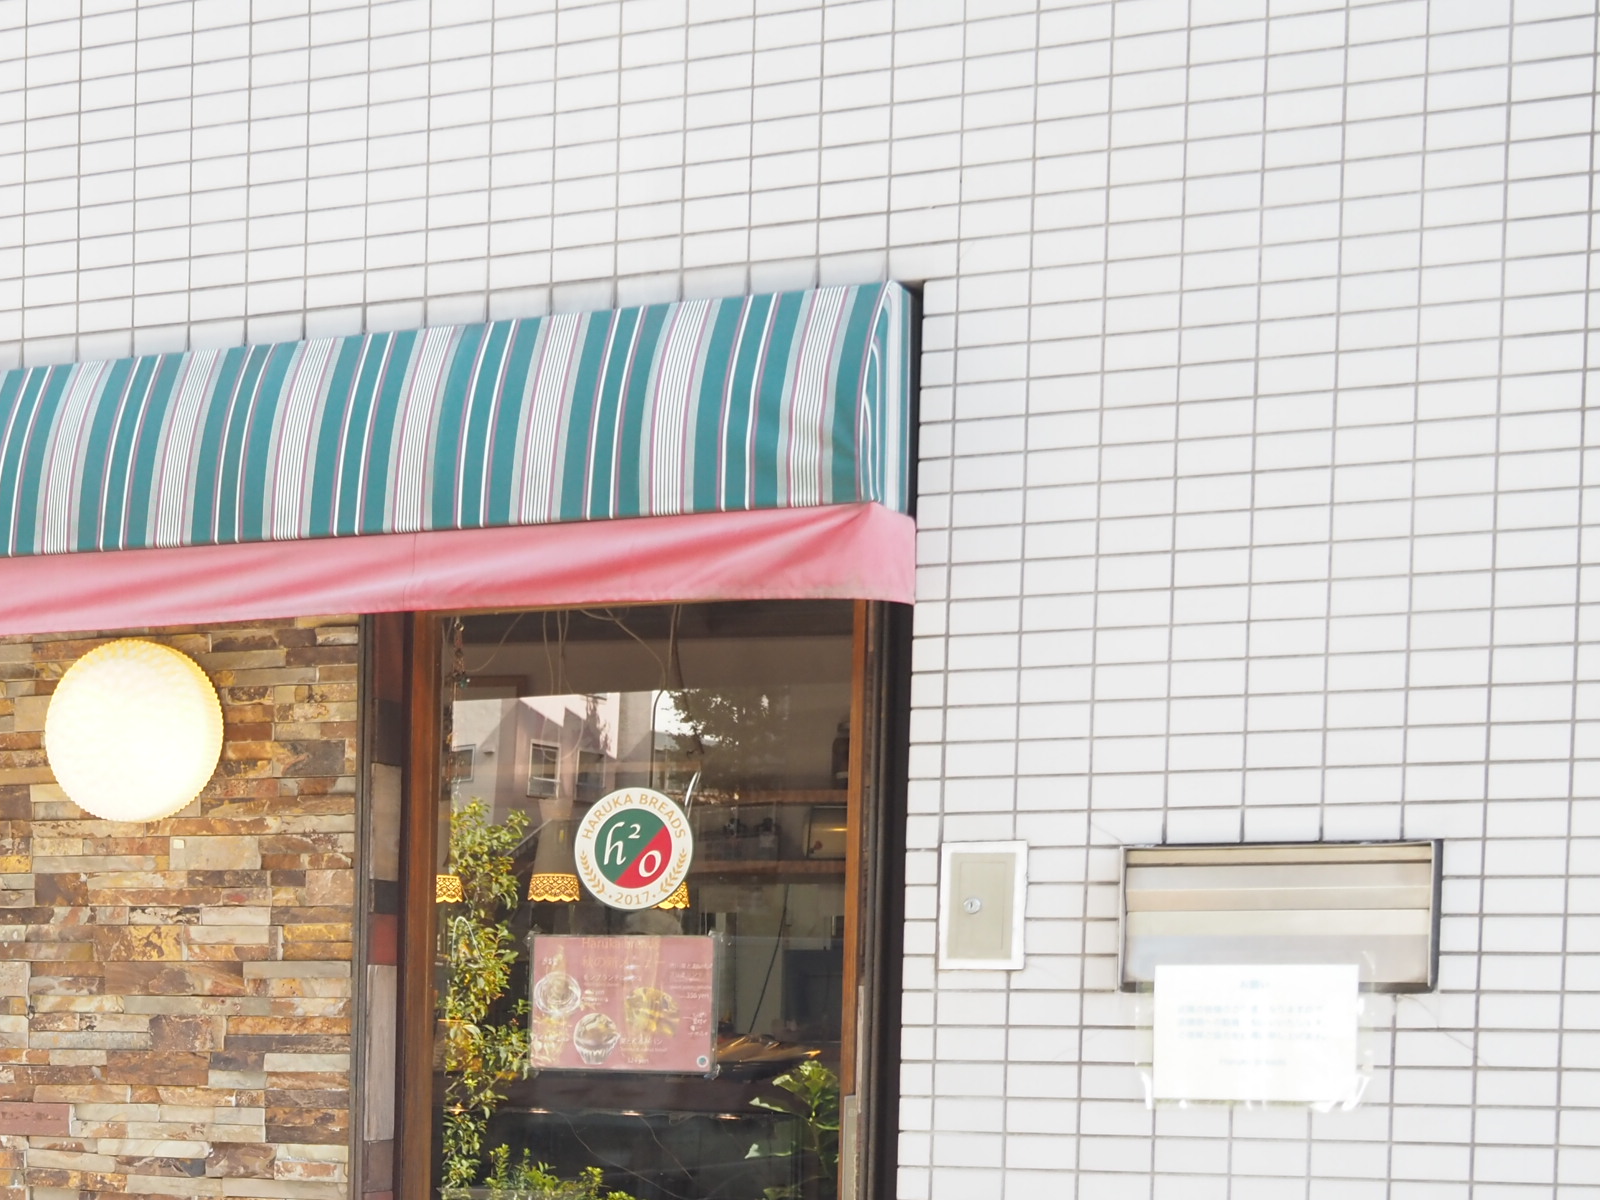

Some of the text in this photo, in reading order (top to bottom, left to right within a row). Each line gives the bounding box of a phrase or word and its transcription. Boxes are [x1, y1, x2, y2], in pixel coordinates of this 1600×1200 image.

[582, 793, 686, 840] HARUKA BREADS
[614, 891, 650, 905] 2017
